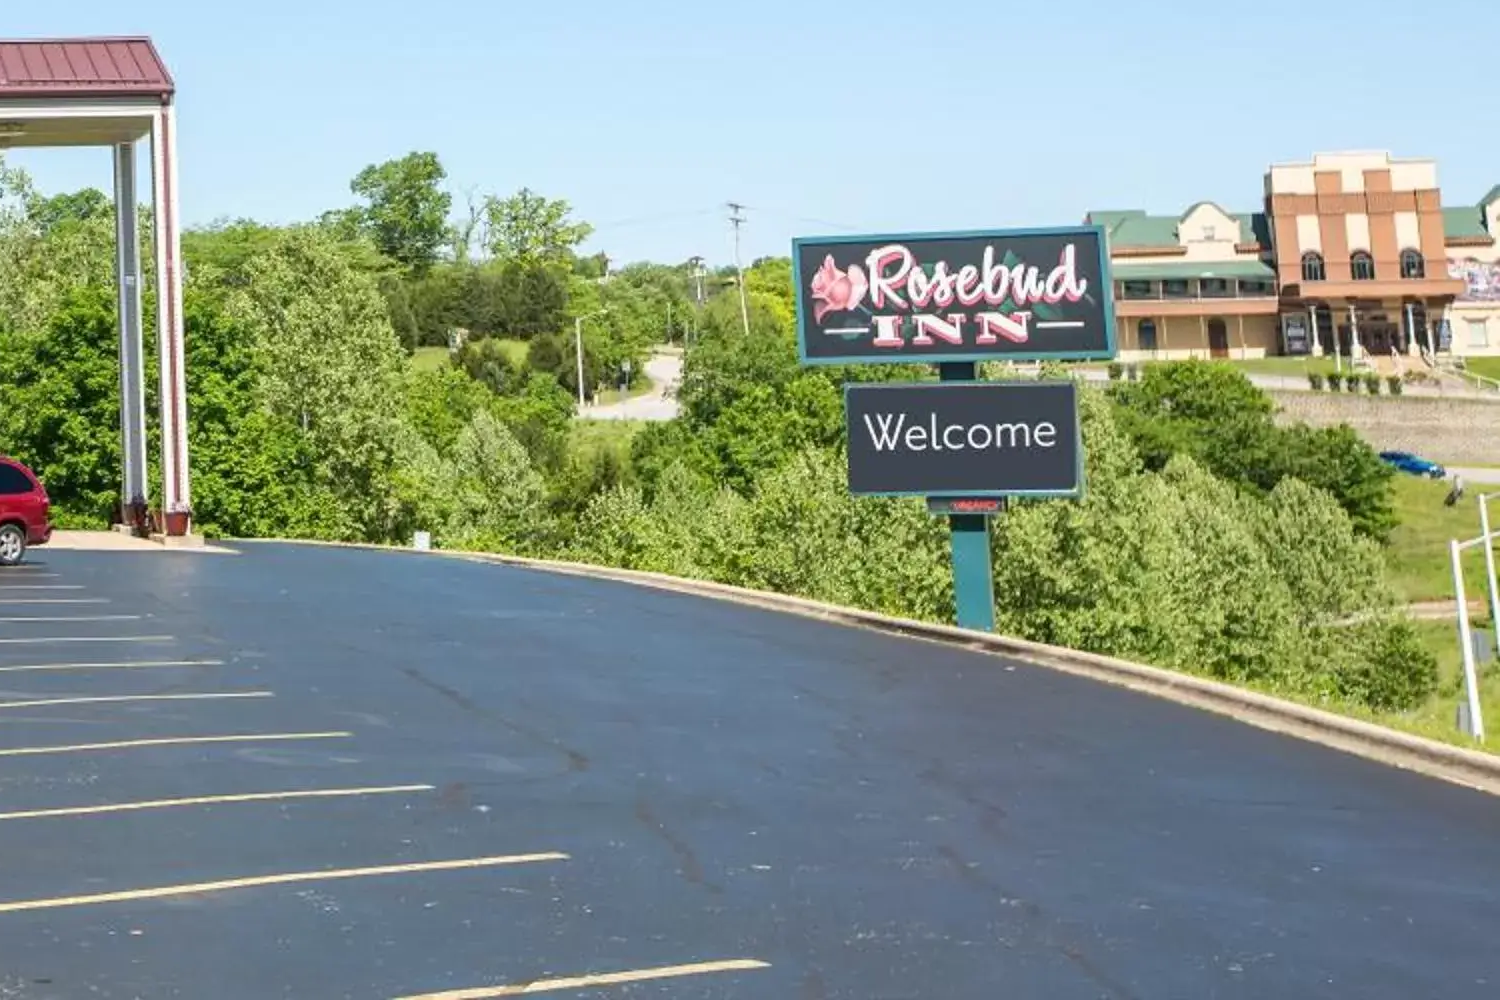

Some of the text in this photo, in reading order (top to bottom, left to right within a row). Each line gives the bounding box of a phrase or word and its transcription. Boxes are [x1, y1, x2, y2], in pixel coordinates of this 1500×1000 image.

[865, 243, 1087, 310] Rosebud
[871, 310, 1033, 348] INN
[863, 411, 1057, 452] Welcome
